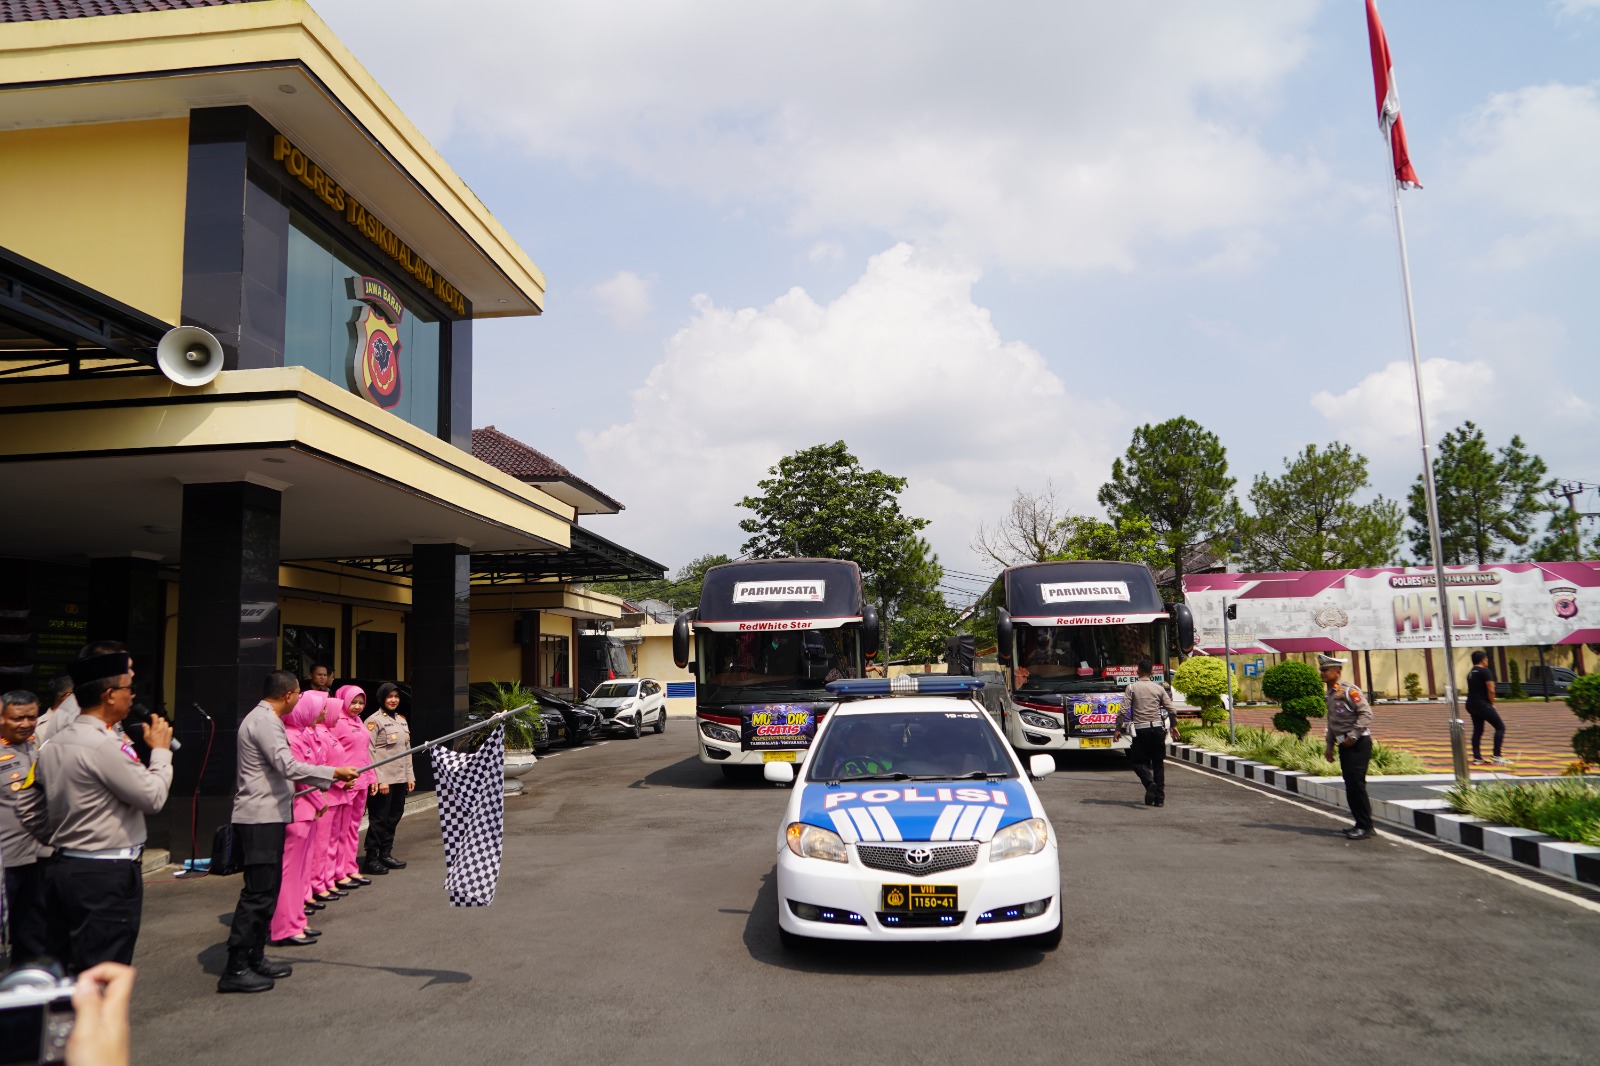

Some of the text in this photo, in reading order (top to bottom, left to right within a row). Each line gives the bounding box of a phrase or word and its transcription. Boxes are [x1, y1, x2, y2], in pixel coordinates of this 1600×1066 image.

[273, 134, 466, 316] POLRES TASIKMALAYA KOTA
[365, 281, 402, 315] JAWA BARAT
[1392, 574, 1496, 586] POLRES TASMALAYA KOTA
[740, 585, 818, 596] PARIWISATA
[1048, 586, 1123, 597] PARIWISATA
[1393, 590, 1507, 634] HADE
[66, 620, 88, 629] PRASET
[738, 621, 813, 631] RedWhite Star
[1056, 616, 1126, 625] RedWhite Star
[1130, 675, 1162, 683] EKOMI
[1074, 703, 1093, 716] MU
[751, 711, 809, 726] MU DIK
[757, 725, 801, 736] GRATIS
[823, 786, 1009, 810] POLISI
[920, 885, 935, 893] VIII
[914, 896, 954, 908] 1150-41
